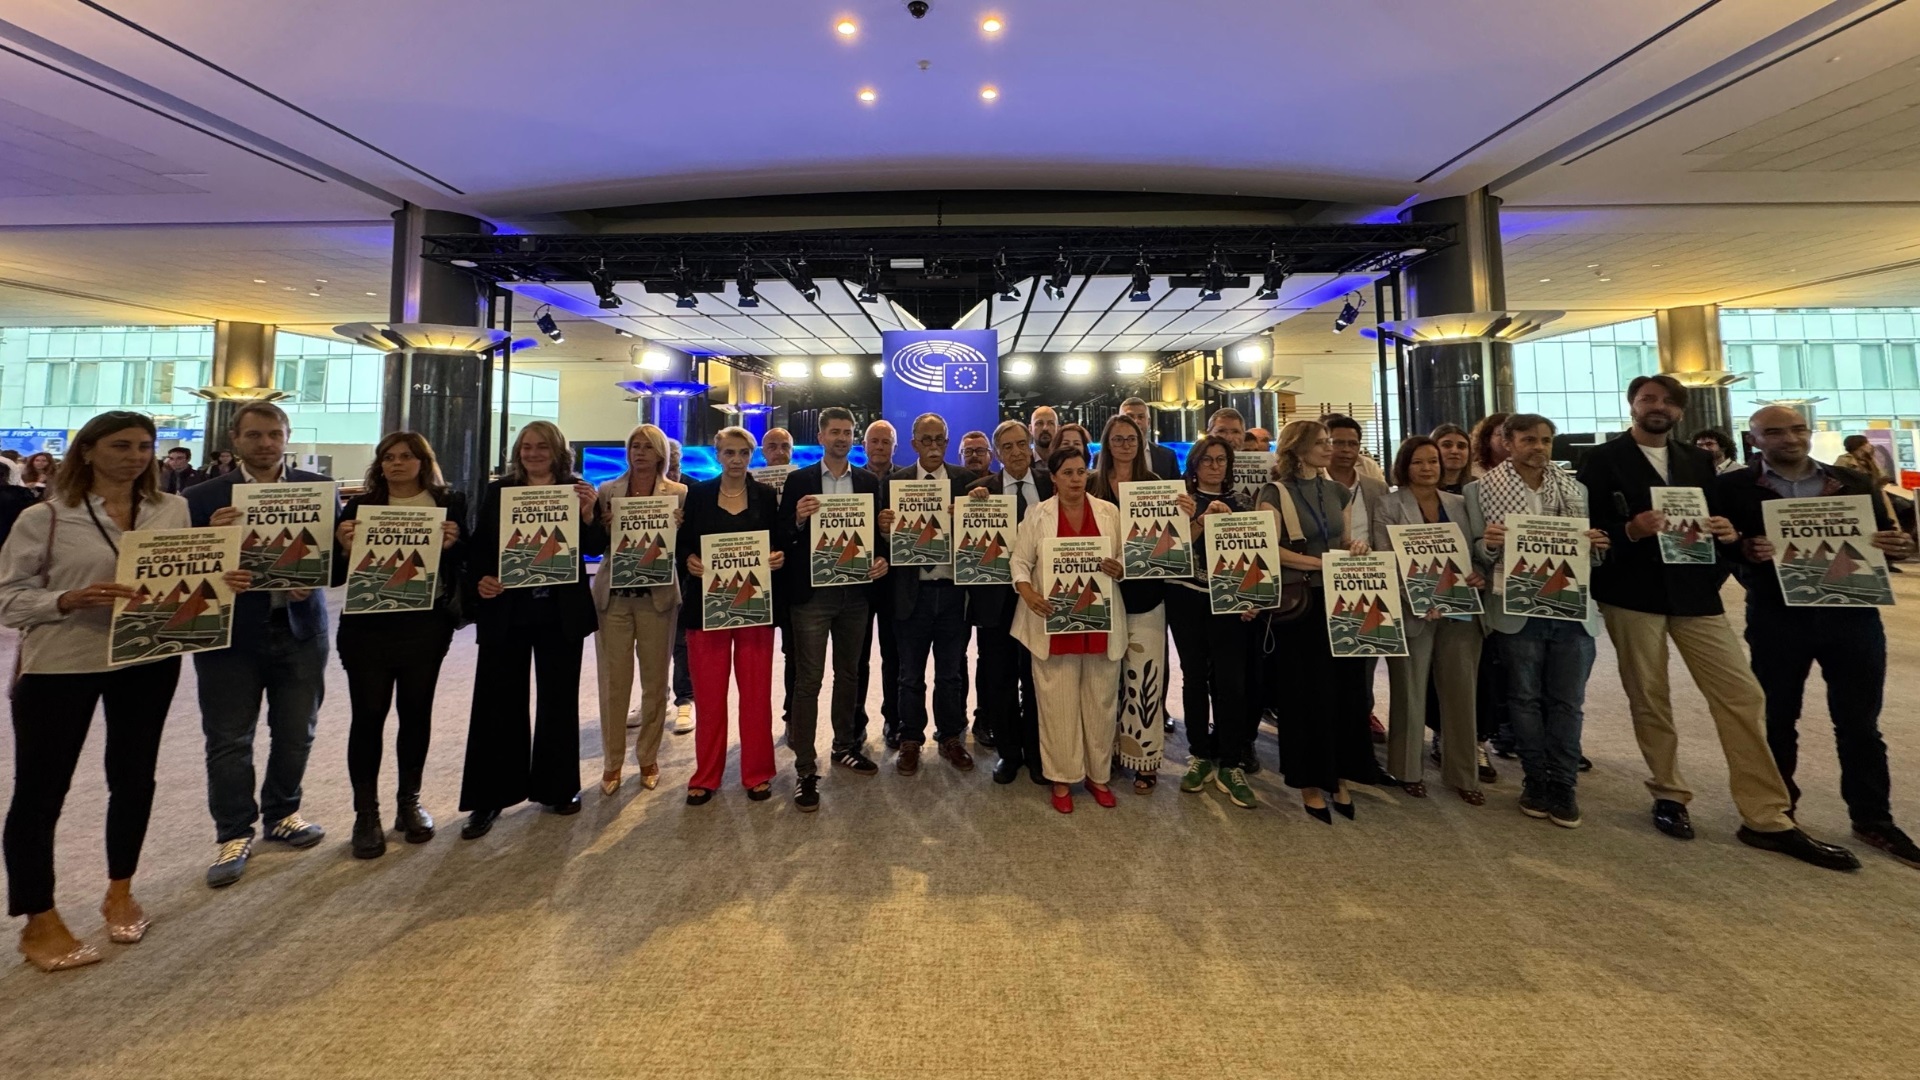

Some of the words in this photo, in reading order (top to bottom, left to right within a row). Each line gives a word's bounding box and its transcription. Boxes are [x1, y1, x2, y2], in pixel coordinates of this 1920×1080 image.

[1234, 475, 1267, 483] OTILLA
[899, 503, 942, 512] FLOTILLA
[1130, 507, 1179, 518] FLOTILLA
[247, 512, 320, 525] FLOTILLA
[512, 512, 568, 524] FLOTILLA
[820, 518, 865, 528] FLOTILLA
[963, 519, 1008, 528] FLOTILLA
[621, 520, 668, 531] FLOTILLA
[1780, 525, 1861, 538] FLOTILLA
[366, 535, 431, 545] FLOTILLA
[1215, 539, 1267, 550] FLOTILLA
[1404, 544, 1458, 555] FLOTILLA
[1517, 542, 1578, 556] FLOTILLA
[137, 555, 182, 565] GLOBAL
[187, 552, 225, 561] SUMUD
[712, 557, 760, 570] FLOTILLA
[136, 561, 224, 579] FLOTILLA
[1053, 563, 1102, 574] FLOTILLA
[1334, 580, 1387, 591] FLOTILLA
